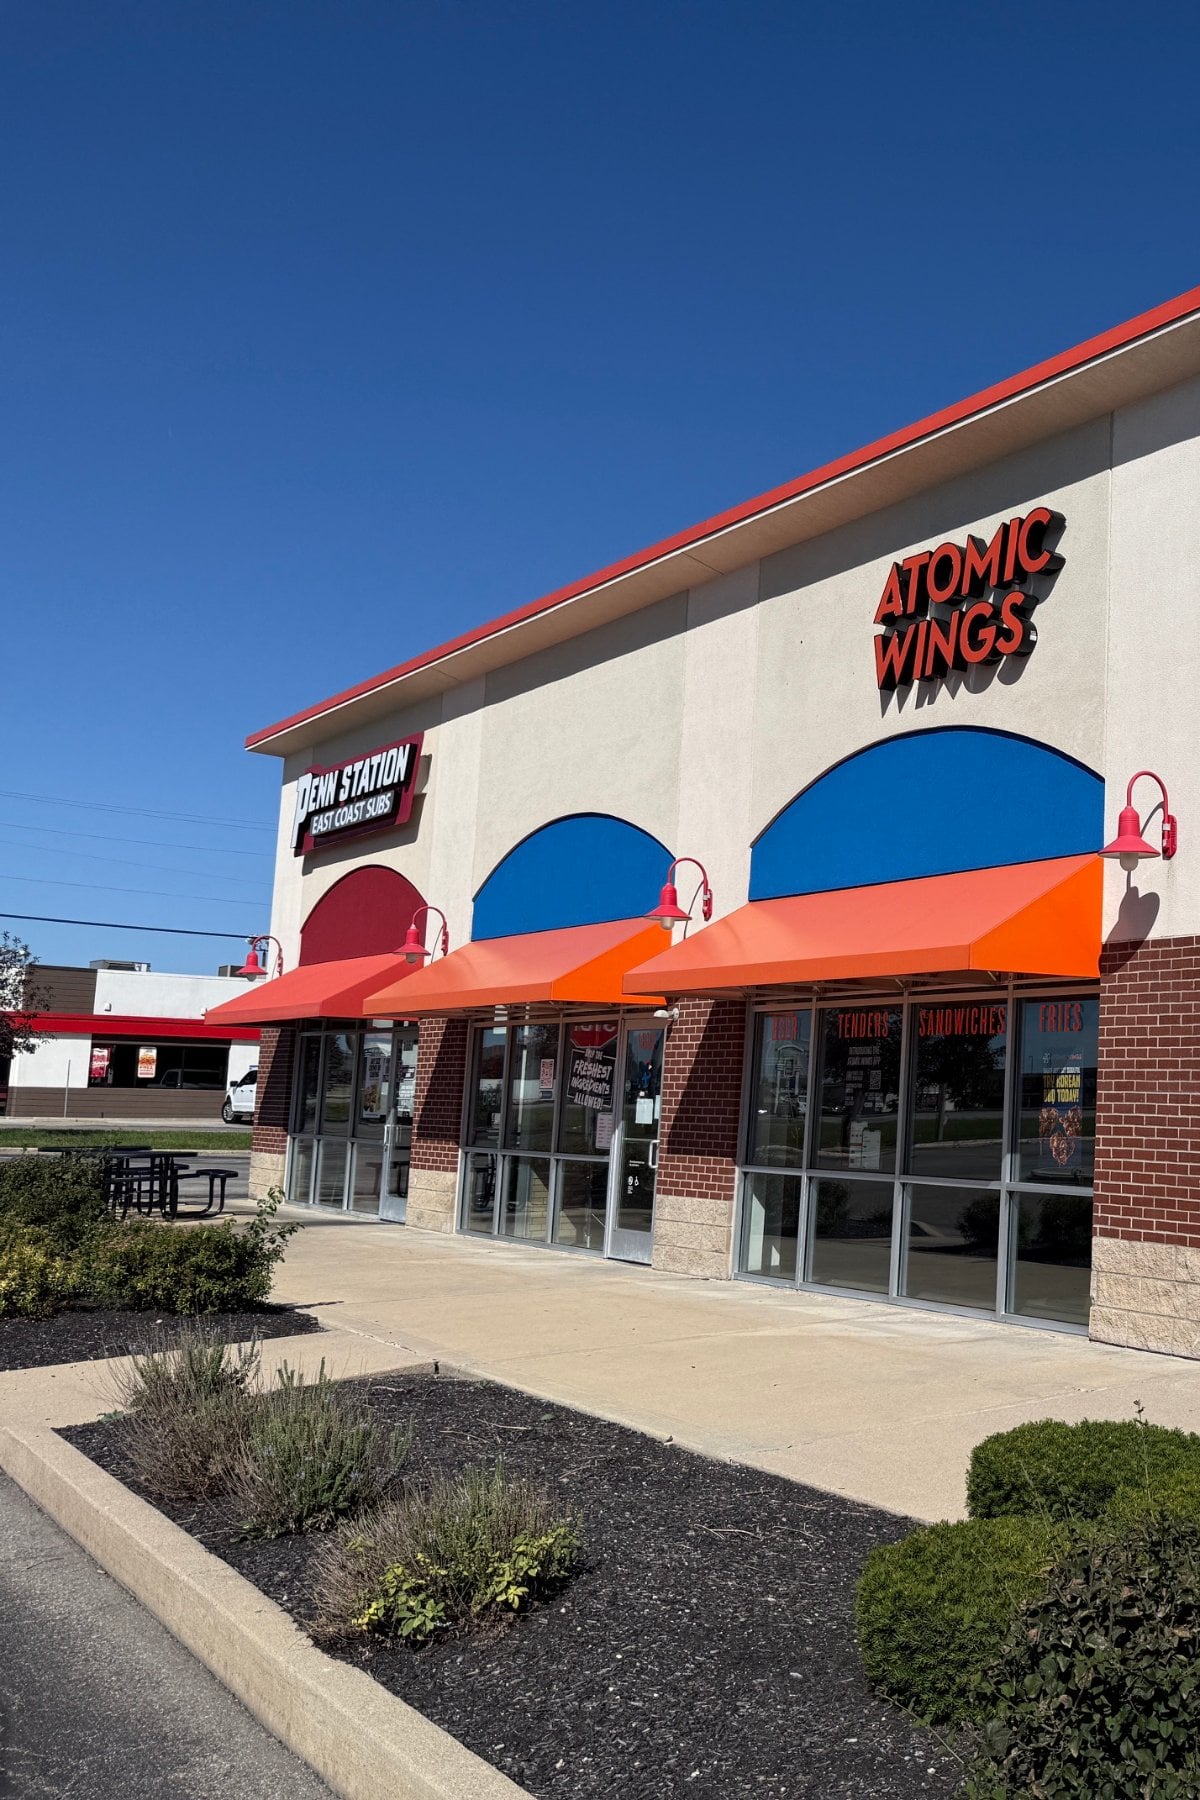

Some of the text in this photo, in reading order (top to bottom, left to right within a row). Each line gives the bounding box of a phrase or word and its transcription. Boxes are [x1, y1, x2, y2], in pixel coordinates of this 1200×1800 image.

[873, 506, 1054, 625] ATOMIC
[873, 590, 1026, 691] WINGS
[289, 743, 411, 849] PENN STATION
[311, 793, 392, 835] EAST COAST SUBS
[837, 1011, 890, 1039] TENDERS
[918, 1007, 1006, 1038] SANDWICHES
[1039, 1003, 1082, 1033] FRIES
[570, 1075, 611, 1095] INGREDIENTS
[573, 1060, 612, 1081] FRESHEST
[1056, 1073, 1081, 1088] KOREAN
[573, 1091, 604, 1110] ALLOWED!
